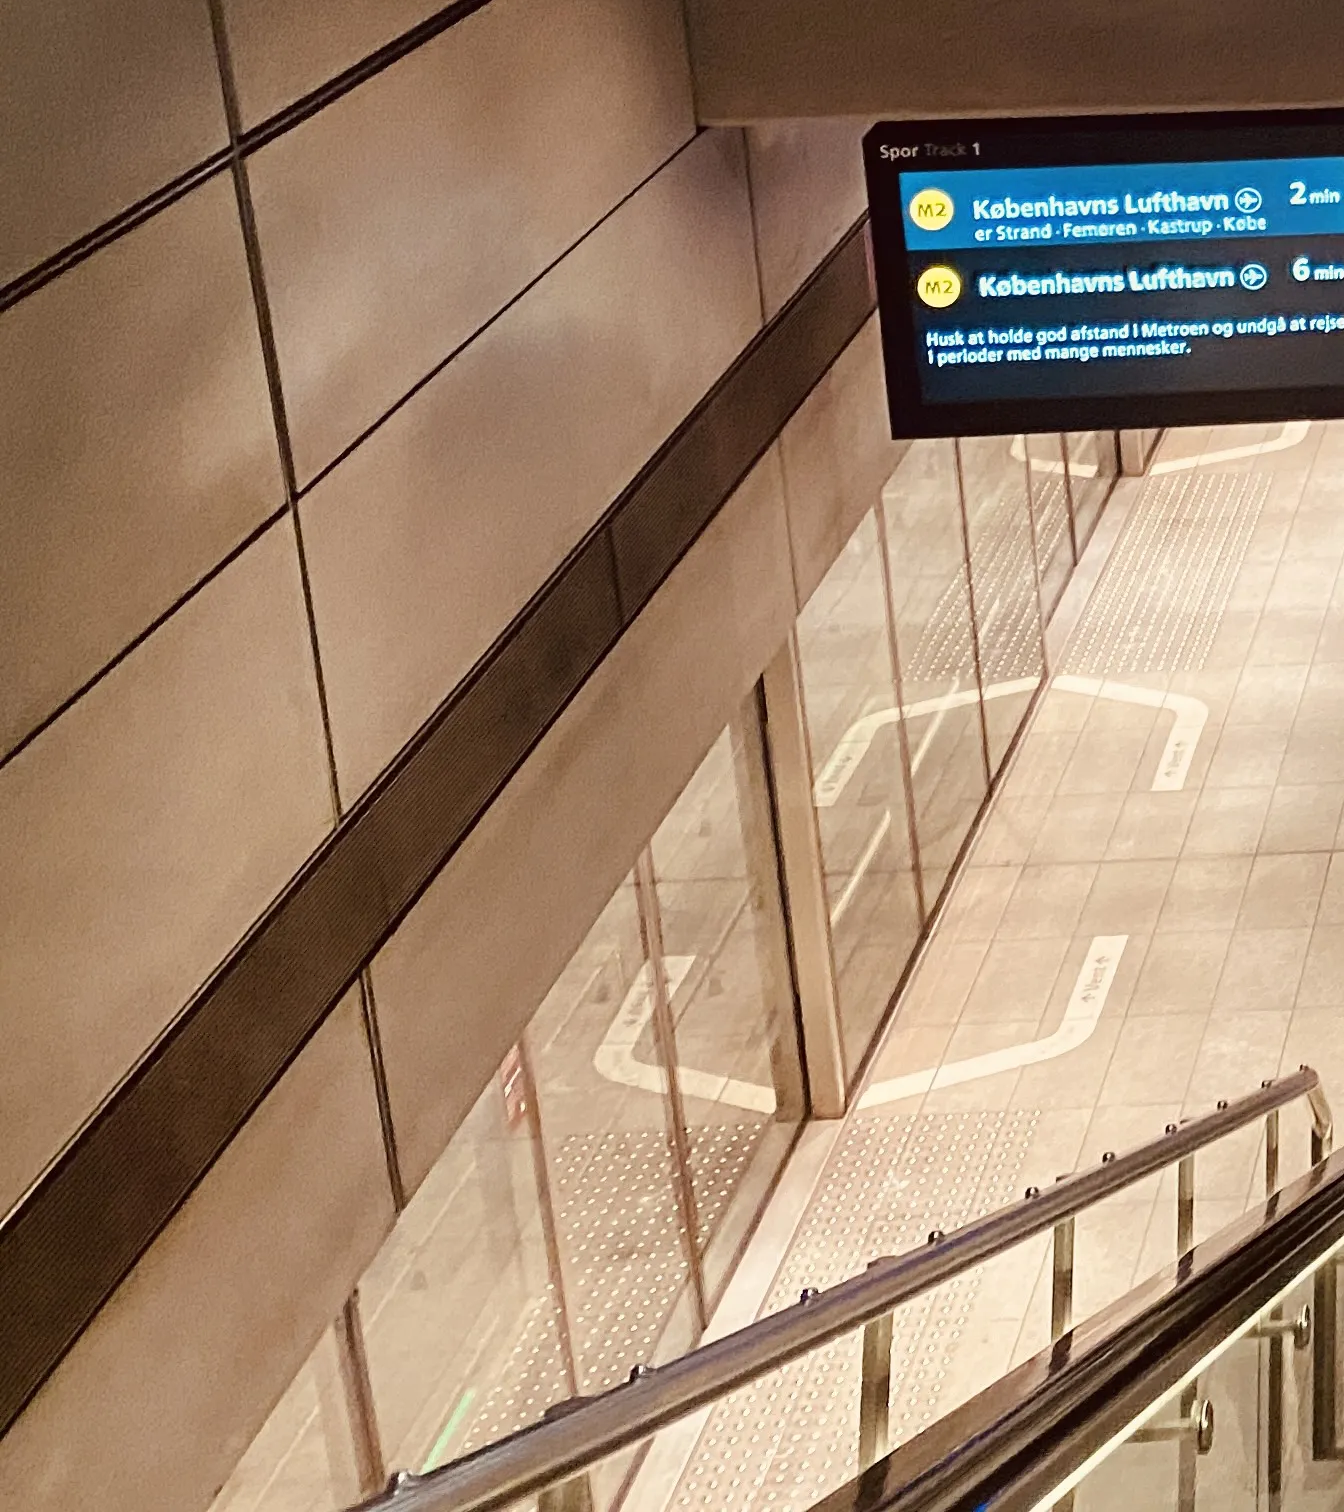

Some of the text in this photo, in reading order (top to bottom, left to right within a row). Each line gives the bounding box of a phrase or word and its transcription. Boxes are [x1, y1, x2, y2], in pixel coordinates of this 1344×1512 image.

[879, 145, 919, 161] Spor
[972, 142, 981, 156] 1
[917, 182, 1340, 220] M2 Københavns Lufthavn 2 min
[974, 215, 1267, 242] er Strand Femøren Kastrup Købe
[925, 281, 953, 294] M2
[978, 272, 1125, 298] Københavns
[1128, 266, 1235, 291] Lufthavn
[1292, 257, 1311, 281] 6
[926, 331, 965, 347] Husk
[967, 331, 985, 345] at
[988, 327, 1033, 344] holde
[1036, 326, 1068, 345] god
[1070, 323, 1130, 341] afstand
[1141, 323, 1209, 339] Metroen
[1211, 322, 1234, 338] og
[1236, 316, 1286, 336] undgå
[1289, 316, 1307, 331] at
[937, 347, 1002, 367] perioder
[1006, 346, 1042, 362] med
[1044, 345, 1099, 362] mange
[1101, 340, 1192, 357] mennesker.
